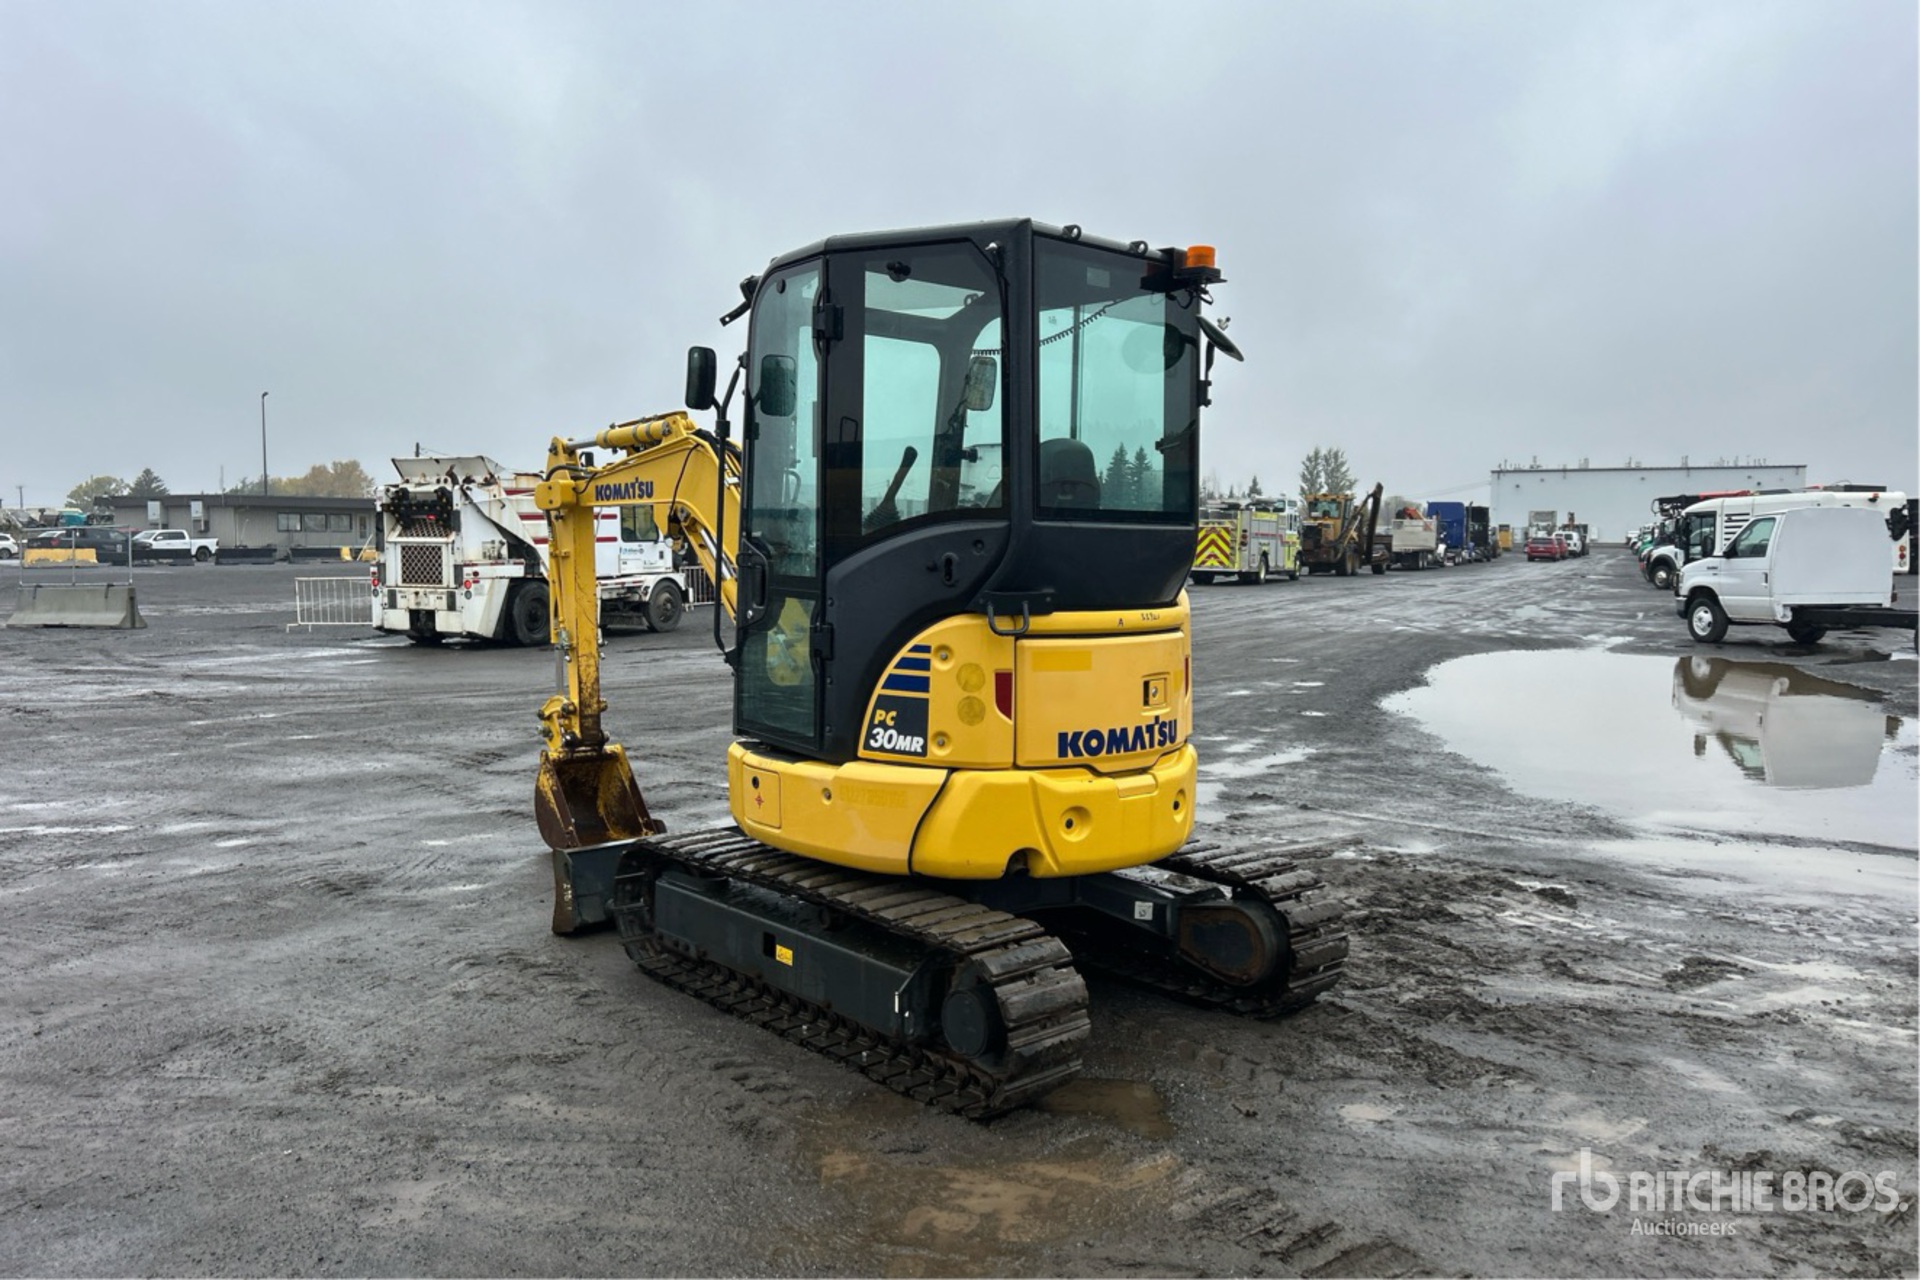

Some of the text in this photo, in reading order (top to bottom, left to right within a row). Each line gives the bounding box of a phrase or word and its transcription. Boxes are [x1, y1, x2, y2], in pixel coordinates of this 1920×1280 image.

[595, 477, 654, 501] KOMATSU
[873, 709, 897, 727] PC
[869, 727, 925, 752] 30MR
[1057, 715, 1177, 758] KOMATSU
